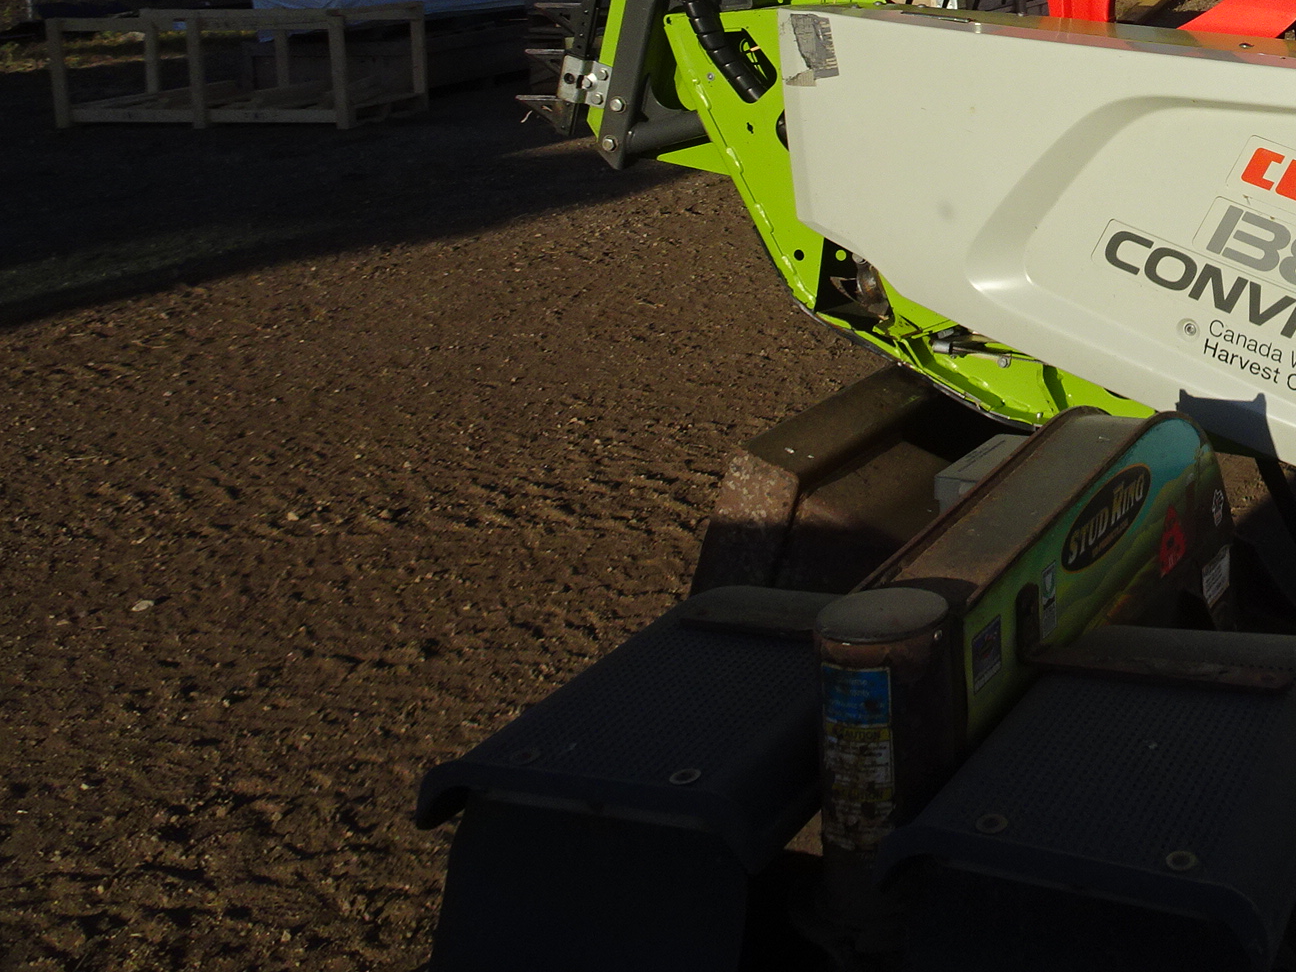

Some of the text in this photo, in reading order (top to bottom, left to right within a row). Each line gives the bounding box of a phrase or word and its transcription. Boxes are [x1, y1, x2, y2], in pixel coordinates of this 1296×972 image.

[1203, 337, 1280, 385] Harvest
[1207, 319, 1283, 365] Canada
[1067, 506, 1110, 565] STUD
[1110, 473, 1146, 526] KING
